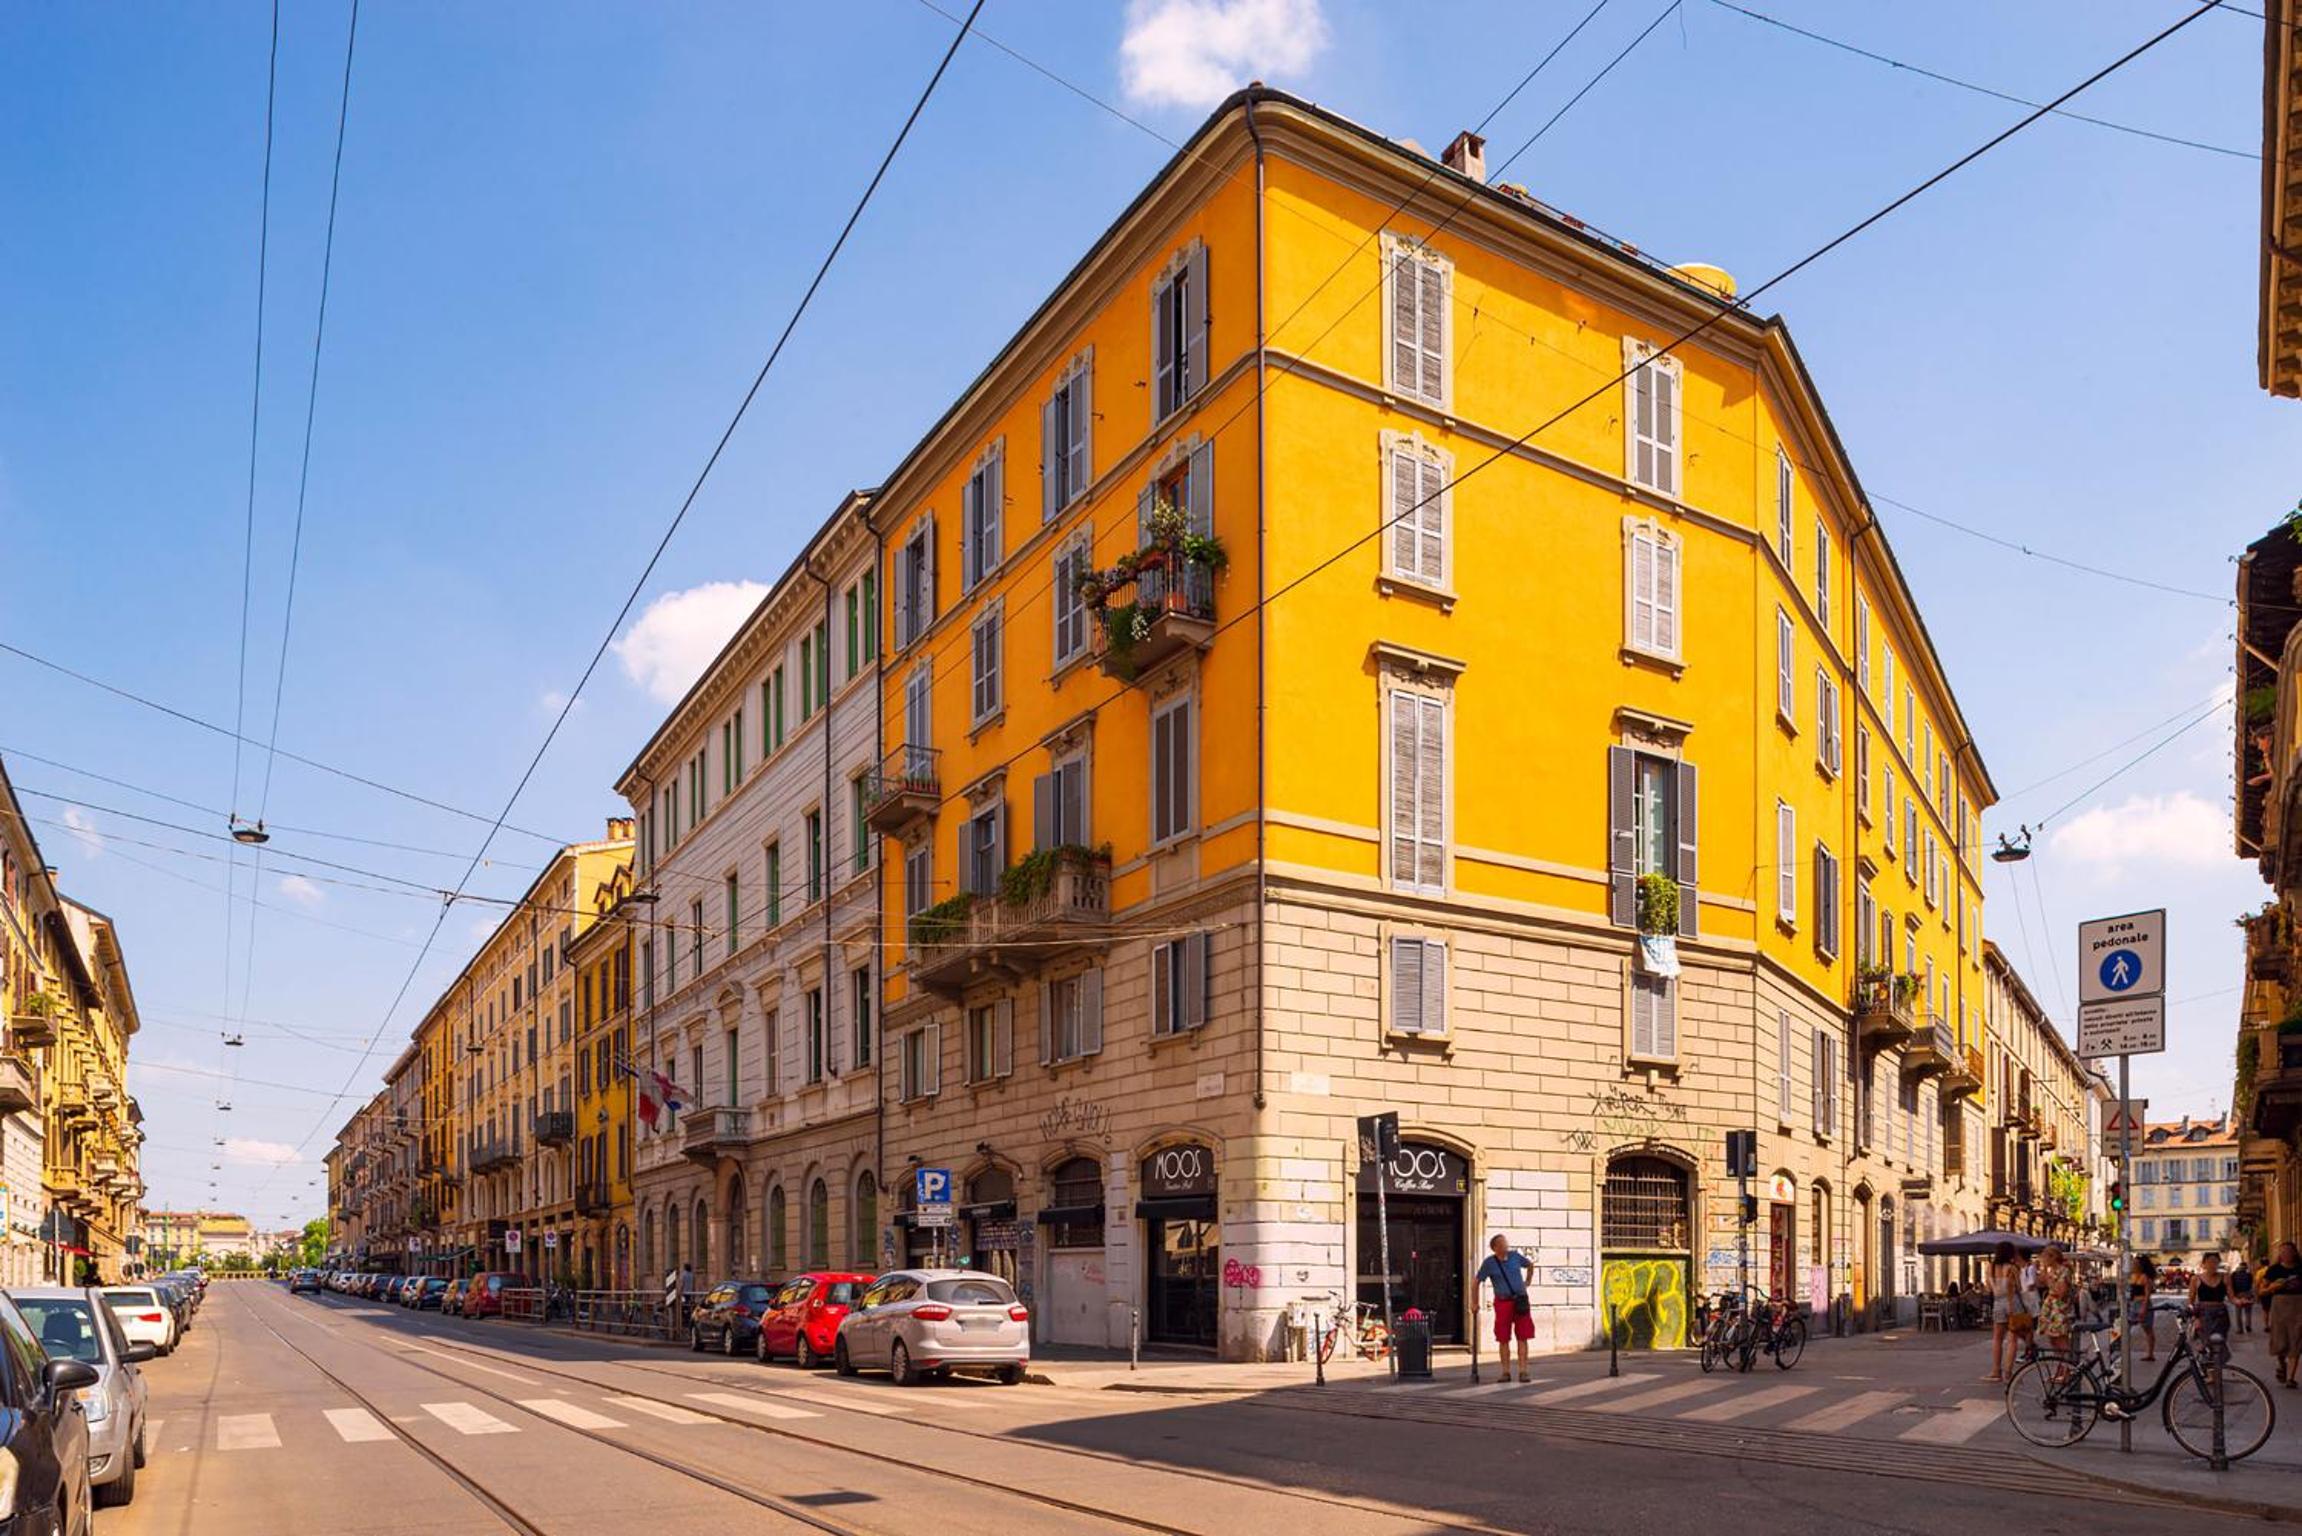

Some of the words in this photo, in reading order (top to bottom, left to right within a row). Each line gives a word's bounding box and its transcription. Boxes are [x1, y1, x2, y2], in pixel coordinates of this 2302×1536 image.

[2108, 922, 2134, 933] area
[2093, 932, 2149, 951] pedonale
[1154, 1149, 1201, 1180] MOOS
[924, 1172, 946, 1200] P
